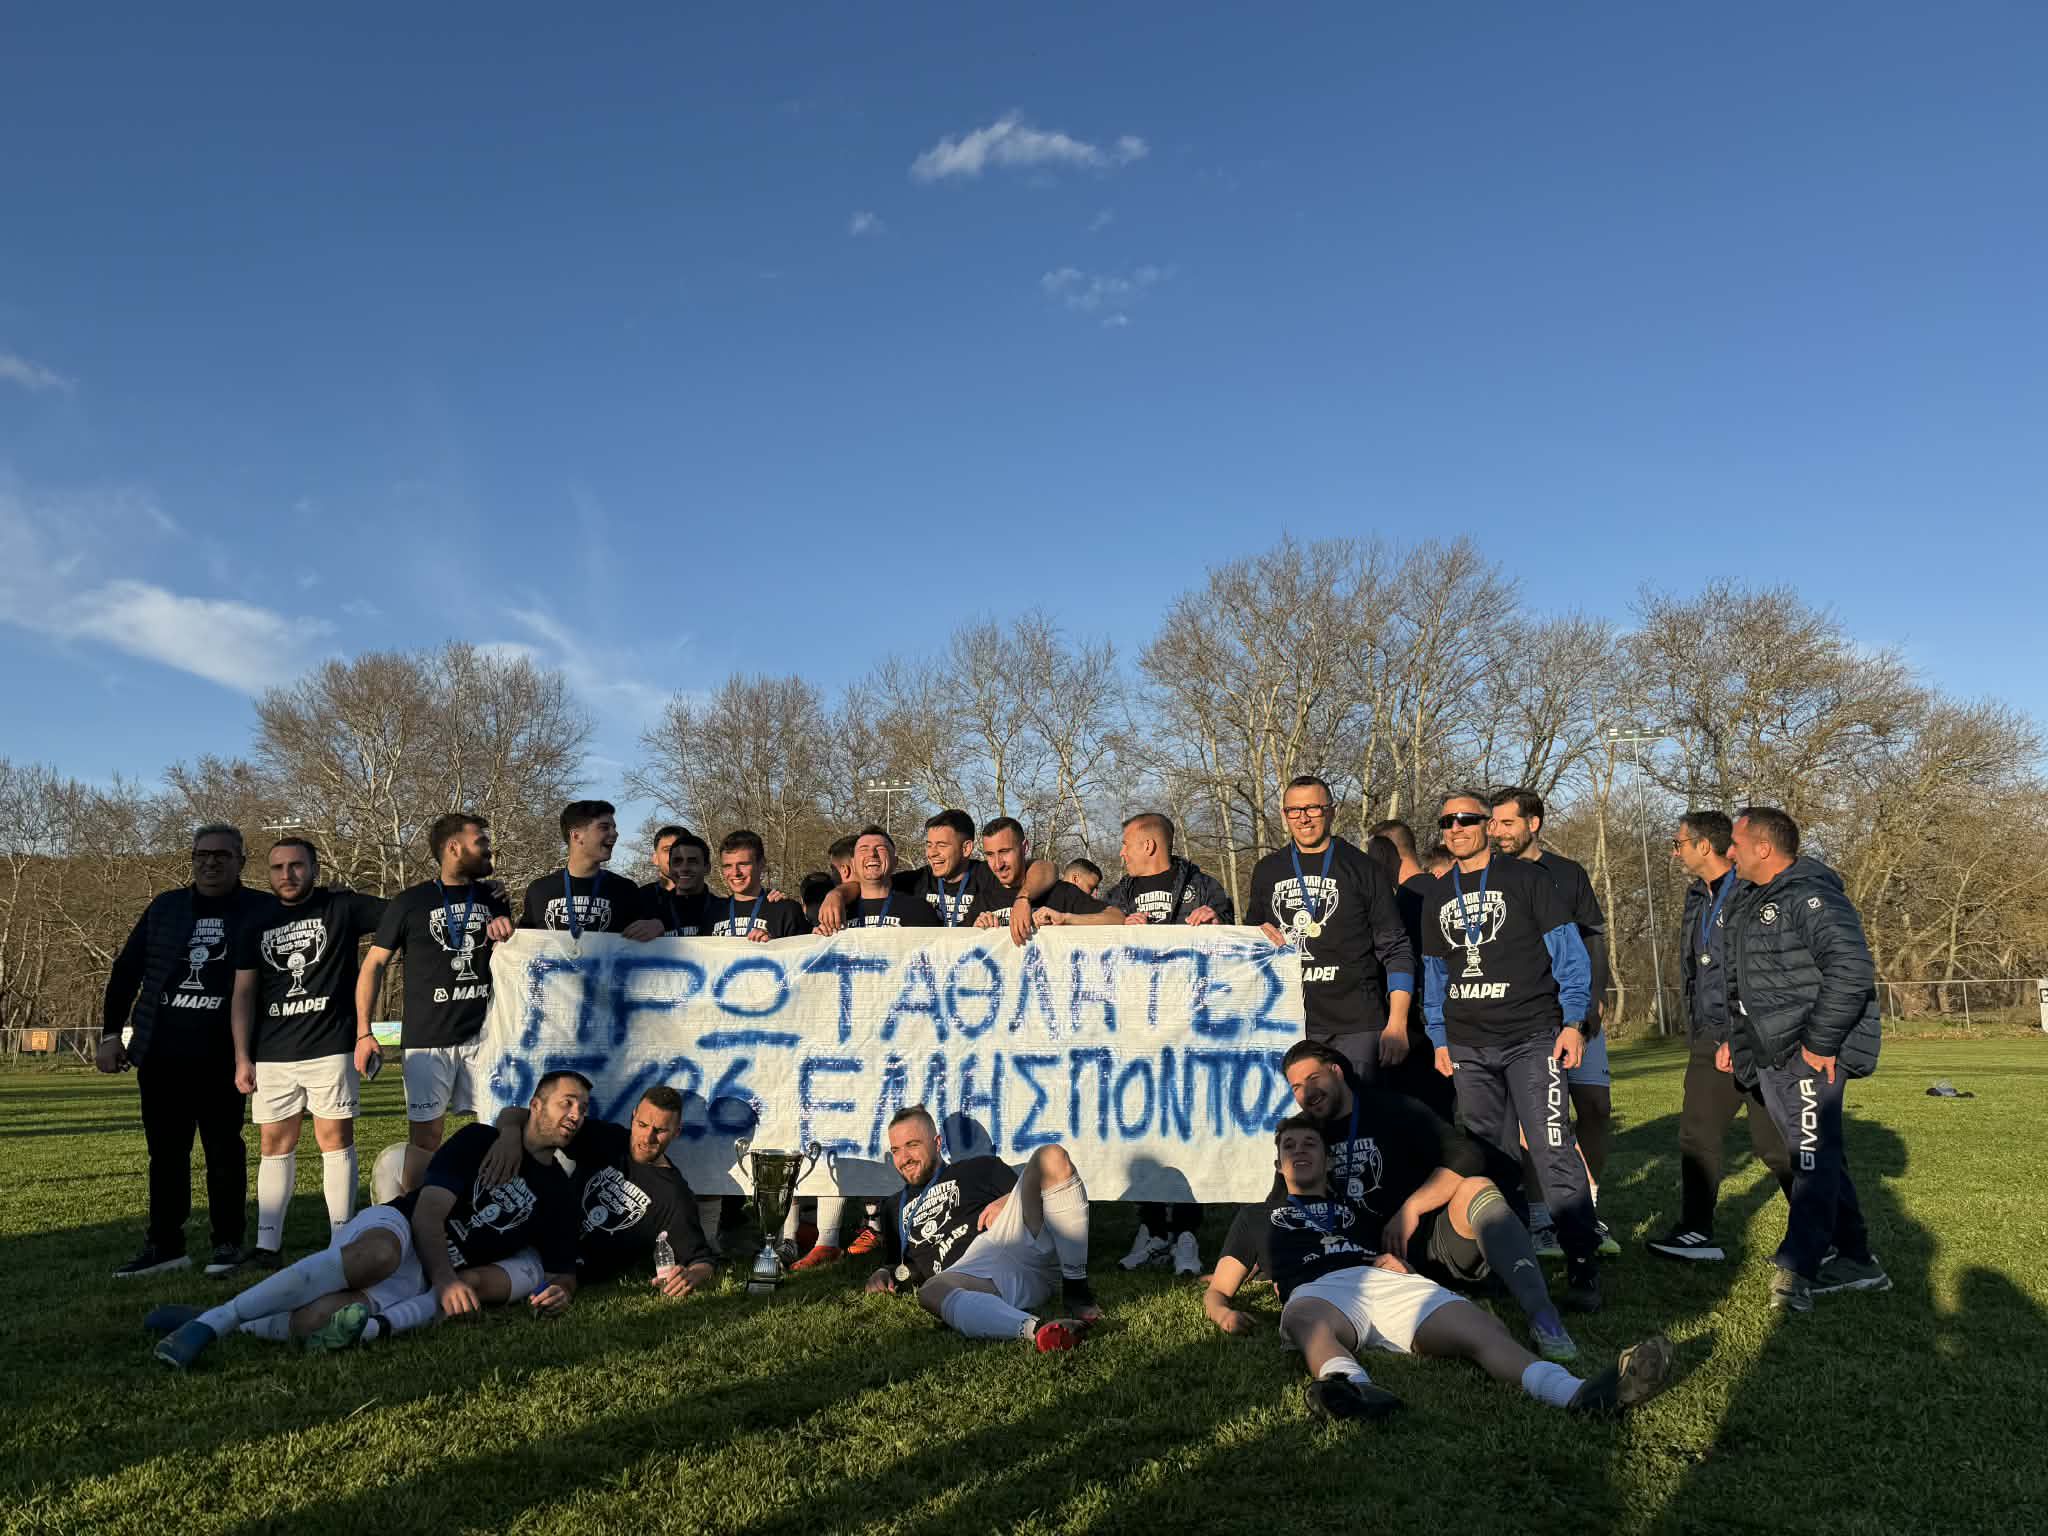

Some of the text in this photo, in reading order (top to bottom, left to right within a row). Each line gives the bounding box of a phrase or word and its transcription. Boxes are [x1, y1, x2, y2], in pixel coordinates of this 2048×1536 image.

[1301, 965, 1339, 982] APEI
[451, 984, 489, 1001] MAPE
[1459, 982, 1510, 1000] MAPEI
[171, 993, 224, 1010] MAPEI
[282, 996, 330, 1017] MAPEI
[1547, 1056, 1562, 1147] GIVOVA
[1799, 1079, 1818, 1171] GIVOVA
